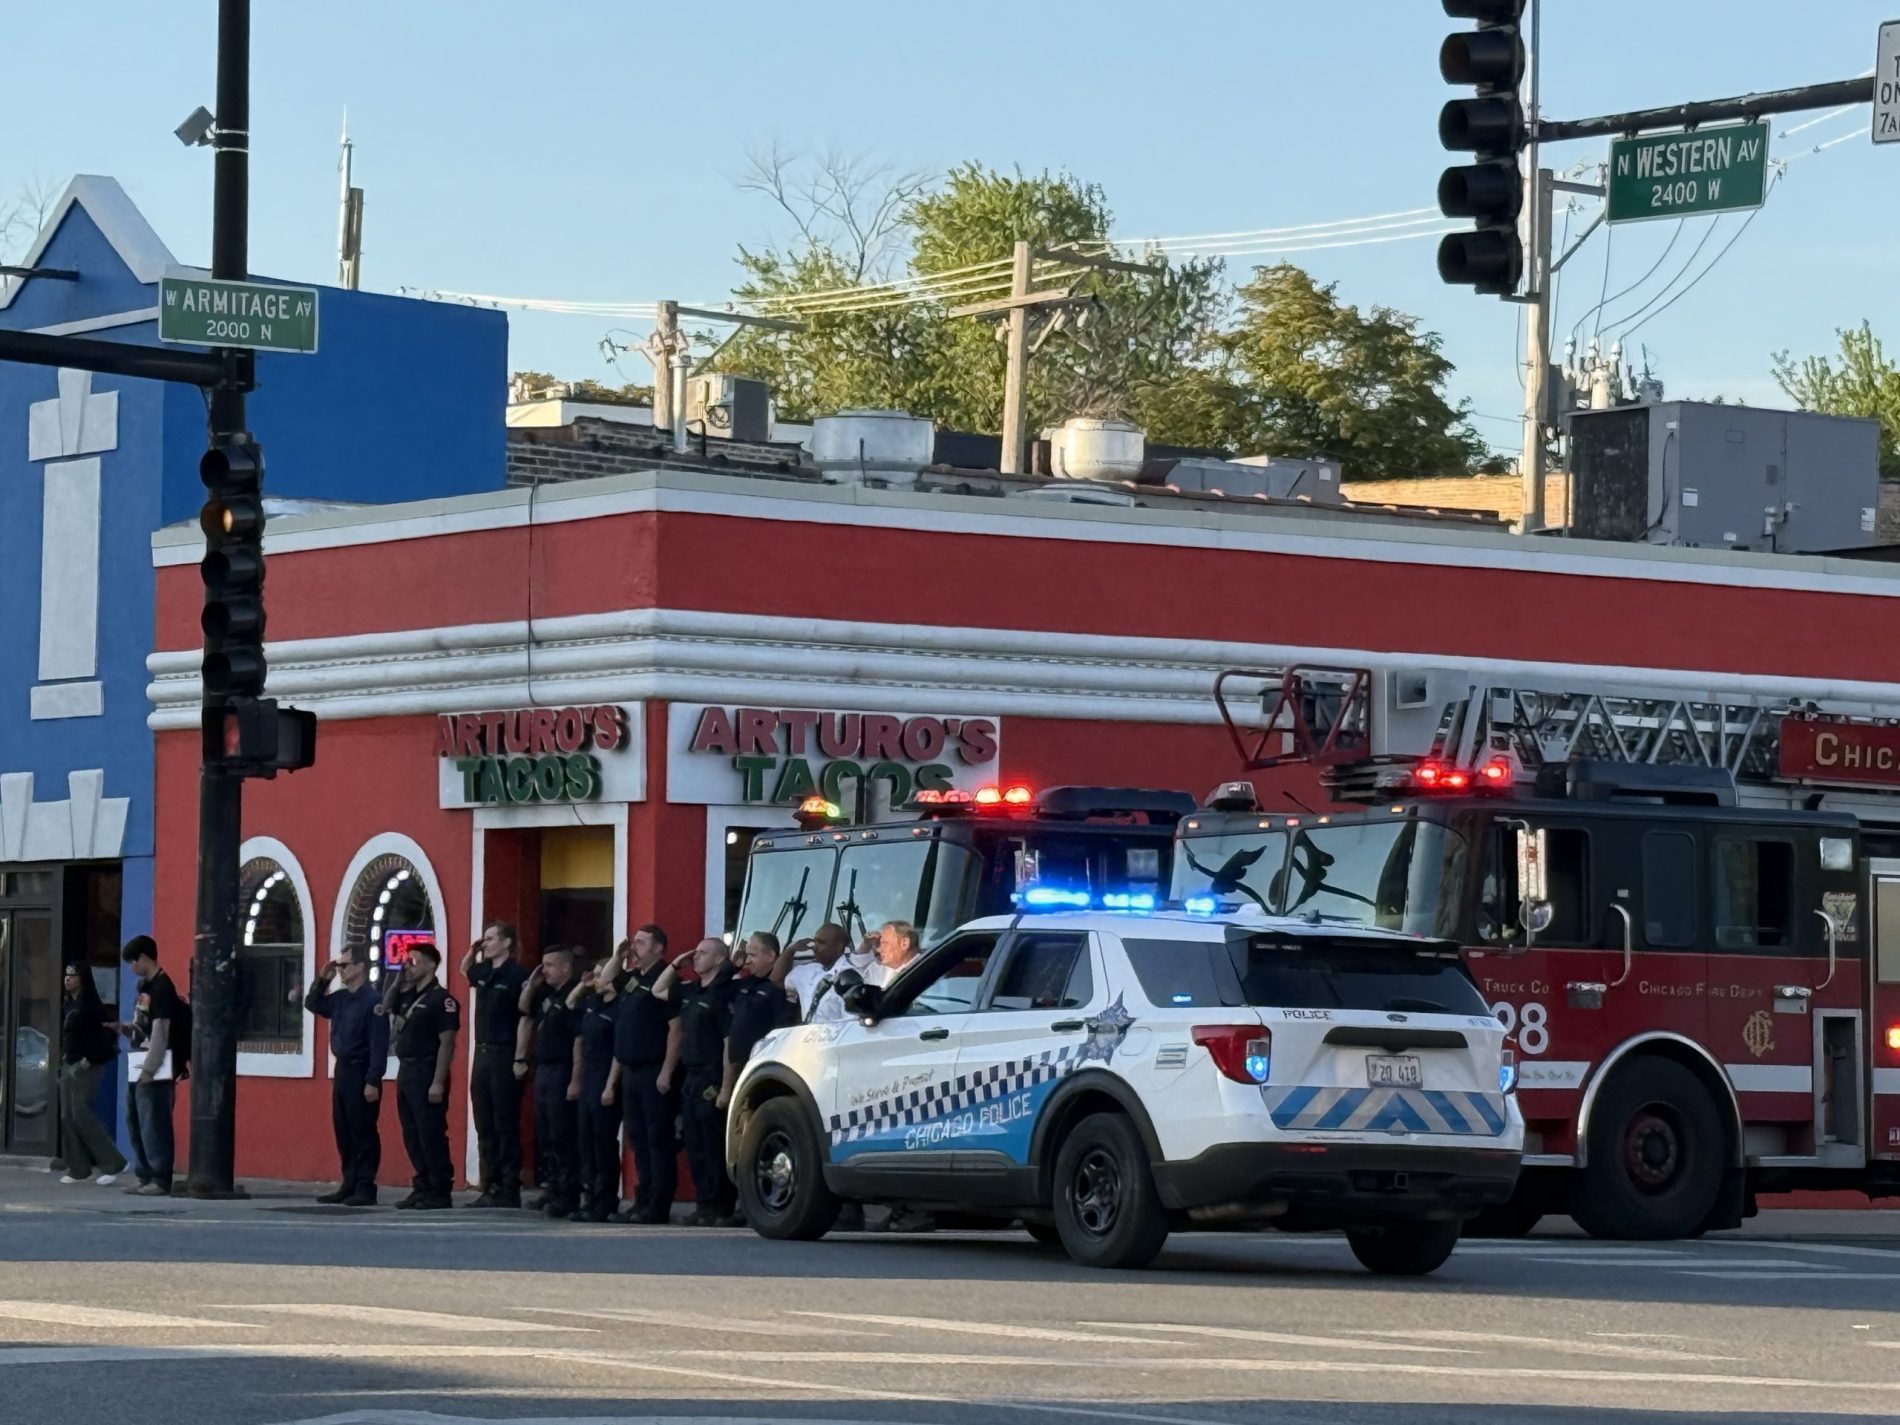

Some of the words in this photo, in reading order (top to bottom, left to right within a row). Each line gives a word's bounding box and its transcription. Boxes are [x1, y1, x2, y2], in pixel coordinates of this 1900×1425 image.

[1880, 112, 1900, 133] 7A
[1617, 153, 1630, 176] N
[1637, 136, 1731, 179] WESTERN
[1736, 137, 1759, 163] AV
[1650, 180, 1698, 207] 2400
[1708, 177, 1721, 201] W
[166, 290, 177, 306] W
[182, 288, 290, 319] ARMITAGE
[206, 320, 250, 339] 2000
[260, 324, 272, 340] N
[434, 705, 622, 757] ARTURO'S
[689, 706, 998, 766] ARTURO'S
[1816, 732, 1900, 771] CHIC
[456, 753, 599, 803] TACOS
[1483, 978, 1525, 993] TRUCK
[1639, 980, 1692, 997] CHICAGO
[1282, 1009, 1333, 1020] POLICE
[904, 1113, 974, 1150] CHICAGO
[979, 1093, 1032, 1129] POLICE
